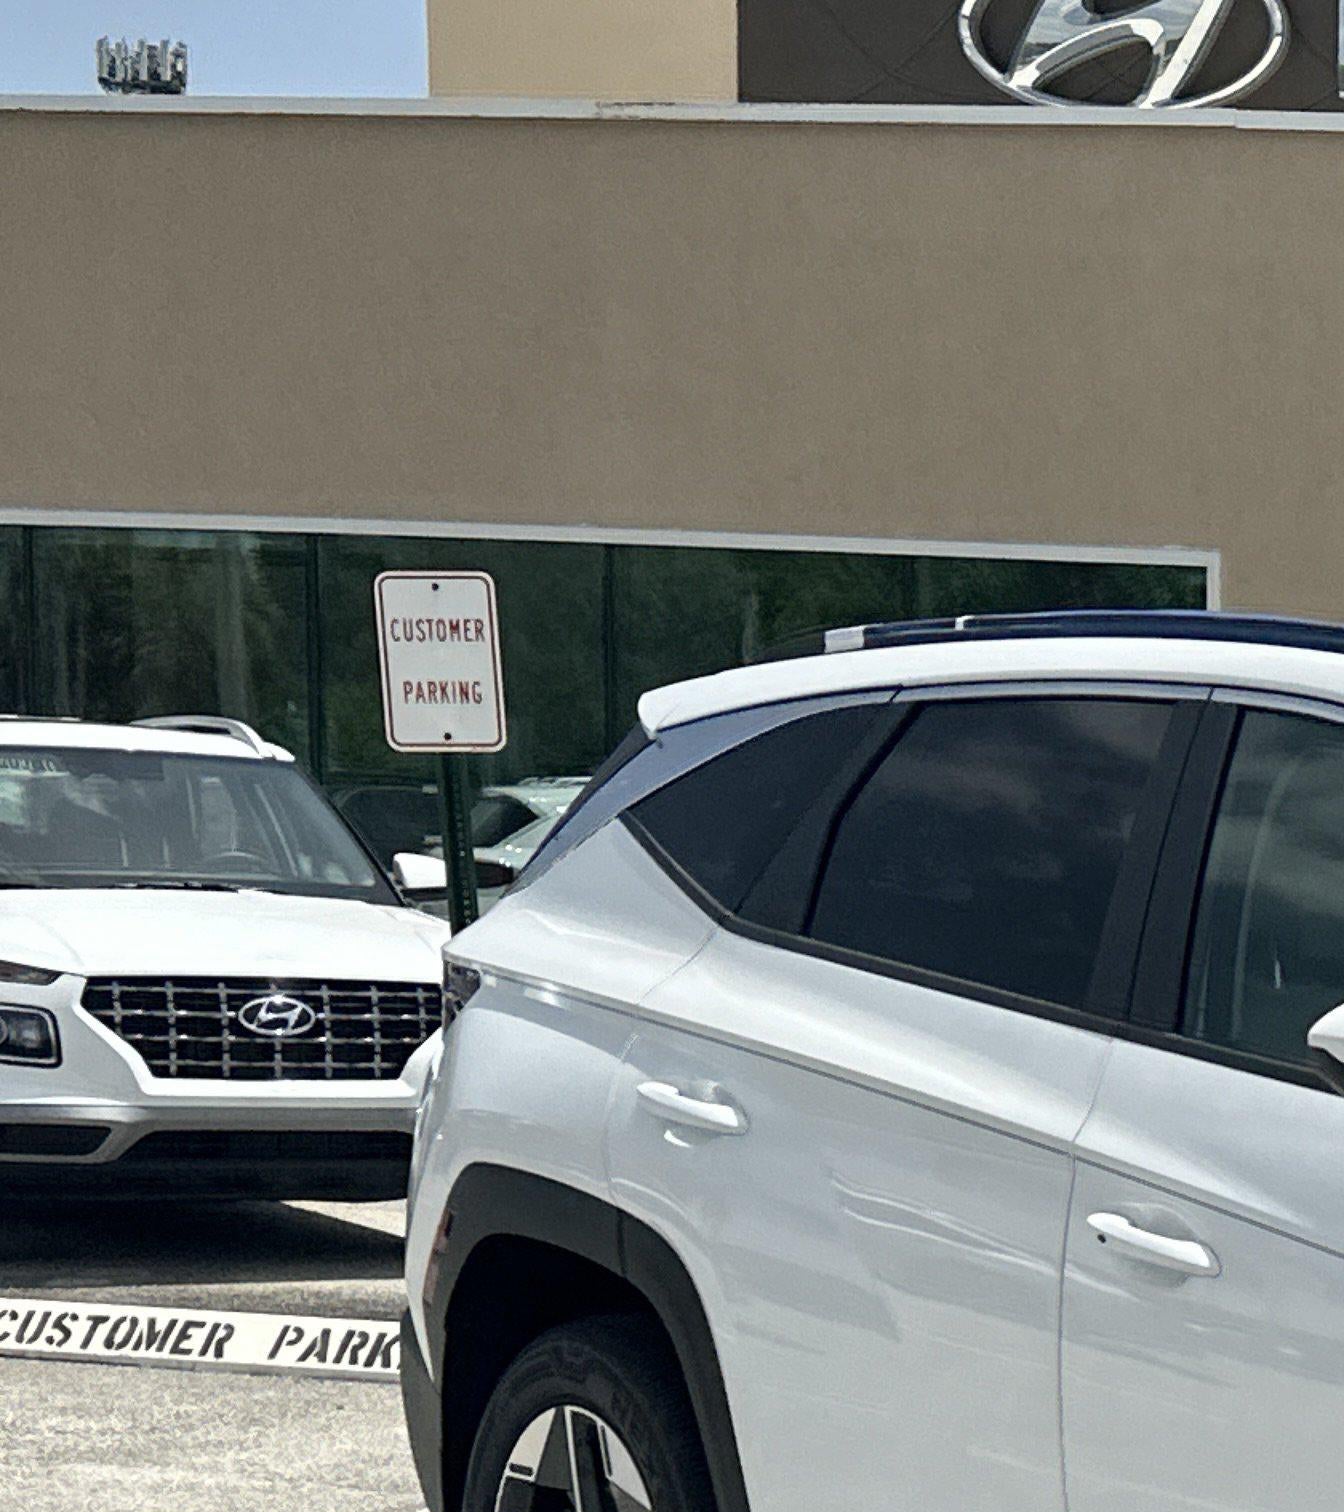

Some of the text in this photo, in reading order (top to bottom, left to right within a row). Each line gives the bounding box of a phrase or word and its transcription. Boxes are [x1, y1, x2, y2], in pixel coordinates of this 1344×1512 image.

[390, 618, 485, 643] CUSTOMER
[403, 680, 483, 704] PARKING
[0, 1309, 400, 1369] CUSTOMER PARK
